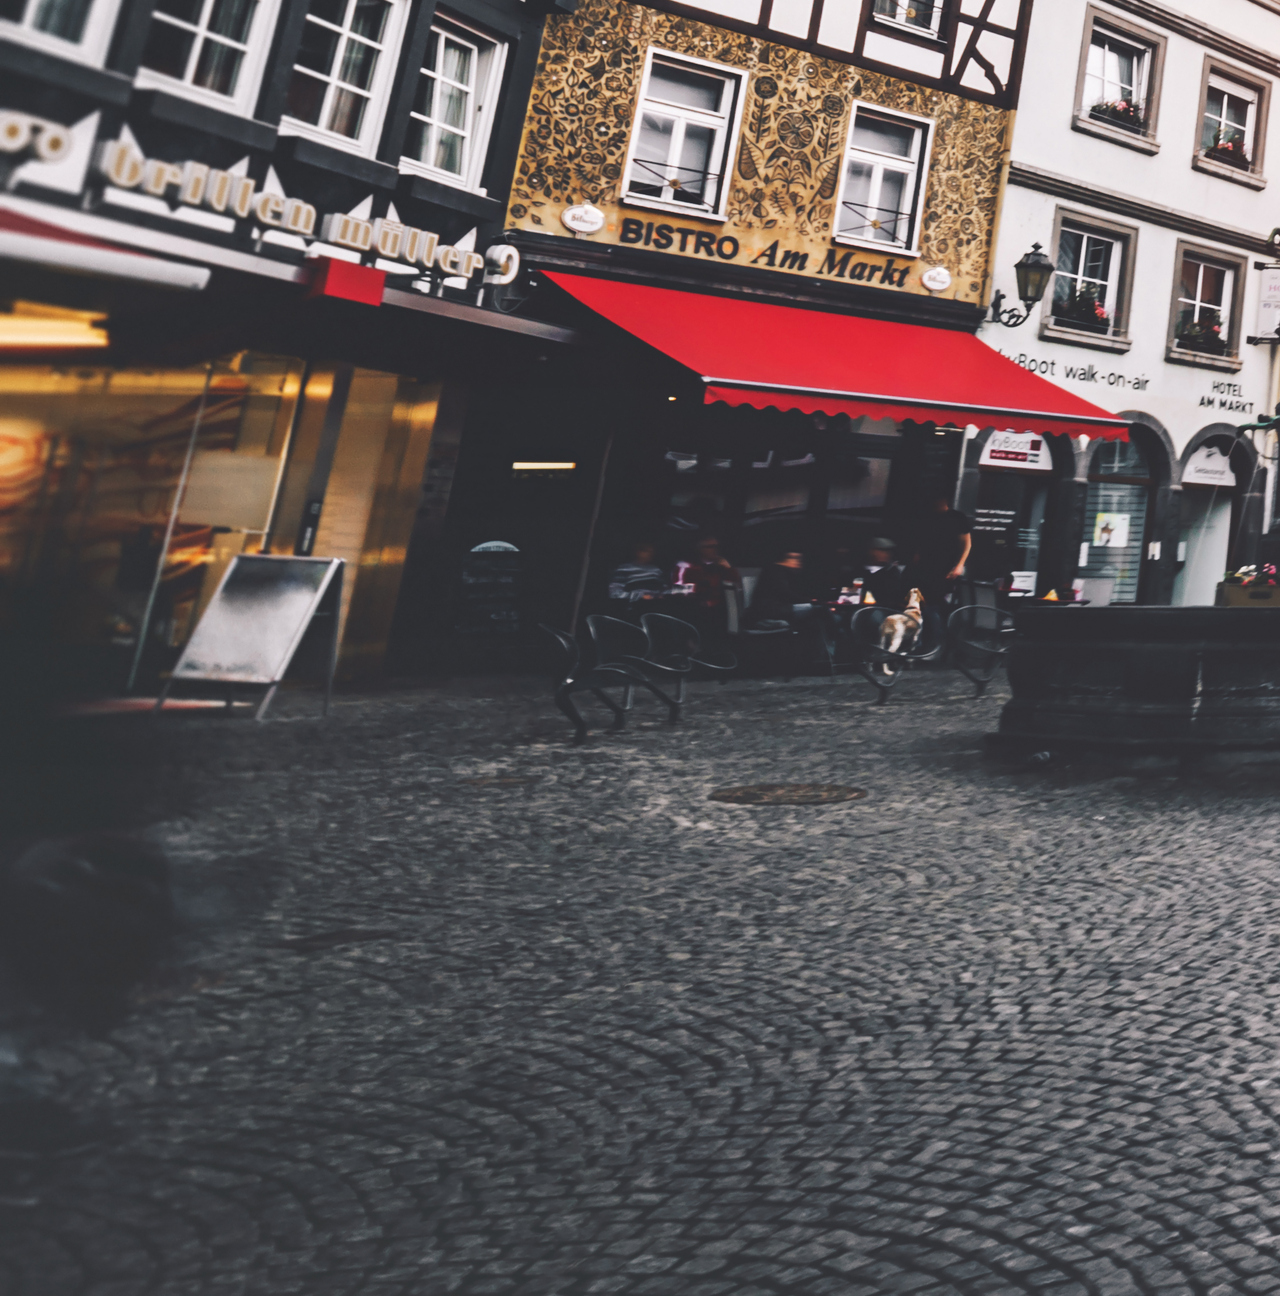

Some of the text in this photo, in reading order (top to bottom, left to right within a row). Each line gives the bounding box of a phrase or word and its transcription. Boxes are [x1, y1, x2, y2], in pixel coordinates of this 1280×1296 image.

[103, 141, 484, 278] brillen müller
[619, 217, 912, 288] BISTRO Am Markt
[1199, 395, 1255, 415] AM MARKT
[1211, 381, 1244, 398] HOTEL
